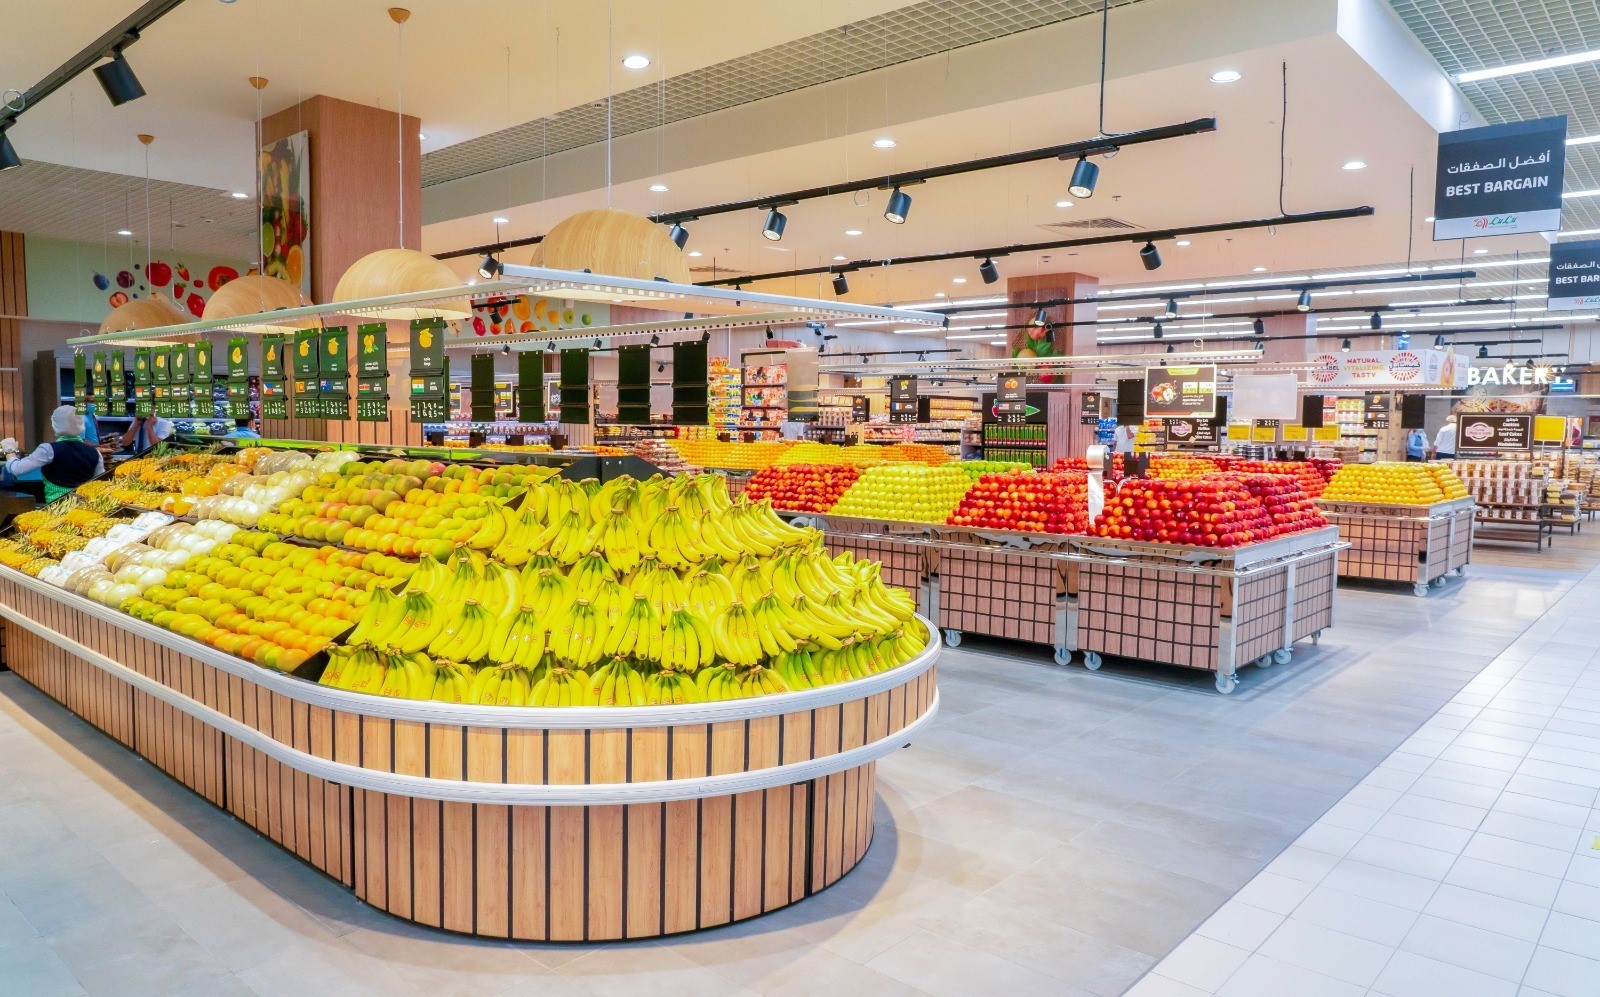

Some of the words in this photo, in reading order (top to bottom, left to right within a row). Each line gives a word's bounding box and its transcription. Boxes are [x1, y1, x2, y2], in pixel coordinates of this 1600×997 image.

[1446, 157, 1506, 174] الصفقات
[1508, 149, 1550, 169] أفضل
[1445, 182, 1480, 197] BEST
[1483, 175, 1549, 194] BARGAIN
[1555, 275, 1578, 285] BEST
